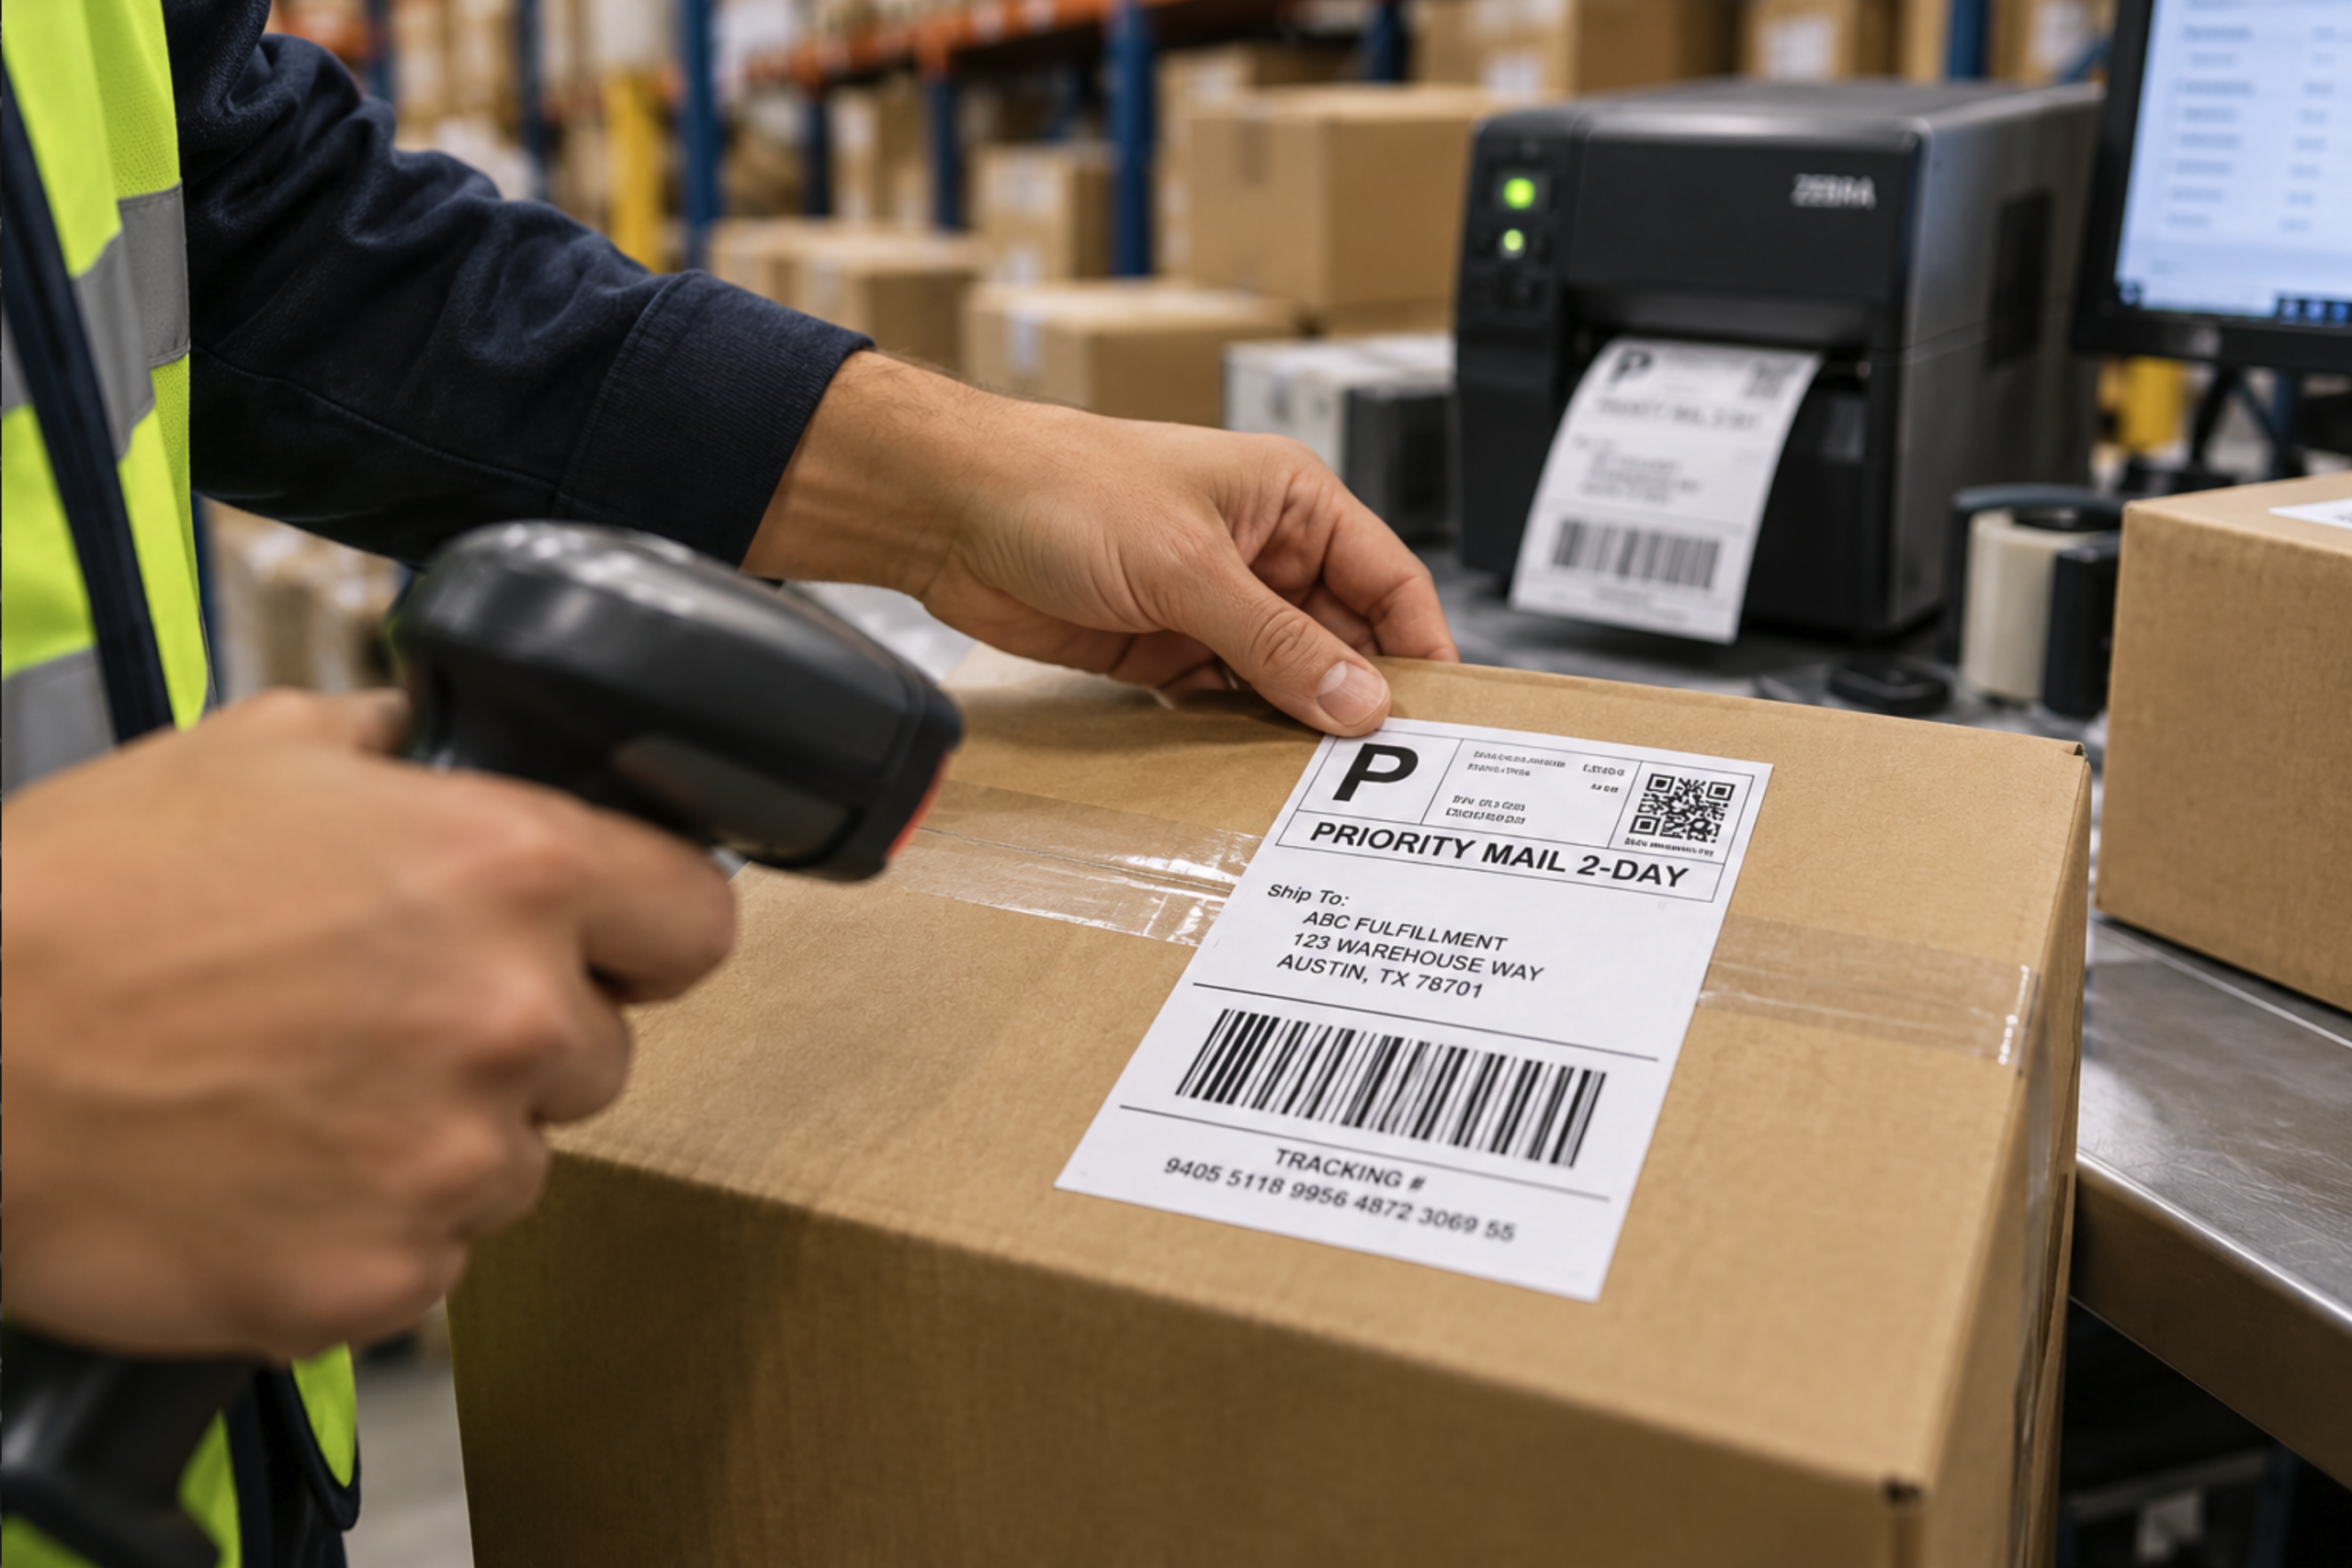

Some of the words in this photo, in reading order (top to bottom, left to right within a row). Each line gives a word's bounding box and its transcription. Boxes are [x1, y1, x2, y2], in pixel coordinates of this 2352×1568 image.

[1791, 174, 1876, 209] ZEBRA
[1332, 742, 1419, 802] P
[1310, 821, 1476, 859] PRIORITY
[1481, 841, 1566, 873] MAIL
[1577, 854, 1689, 887] 2-DAY
[1267, 884, 1312, 904] Ship
[1318, 889, 1350, 907] To:
[1303, 911, 1351, 930] ABC
[1354, 917, 1508, 952] FULFILLMENT
[1277, 953, 1368, 985] AUSTIN,
[1380, 968, 1410, 987] TX
[1416, 975, 1484, 999] 78701
[1294, 932, 1331, 950] 123
[1337, 938, 1486, 973] WAREHOUSE
[1491, 960, 1544, 981] WAY
[1274, 1147, 1403, 1189] TRACKING
[1408, 1175, 1426, 1192] #
[1164, 1156, 1222, 1183] 9405
[1226, 1170, 1284, 1195] 5118
[1289, 1181, 1348, 1208] 9956
[1354, 1195, 1414, 1222] 4872
[1418, 1207, 1479, 1235] 3069
[1484, 1221, 1518, 1244] 55
